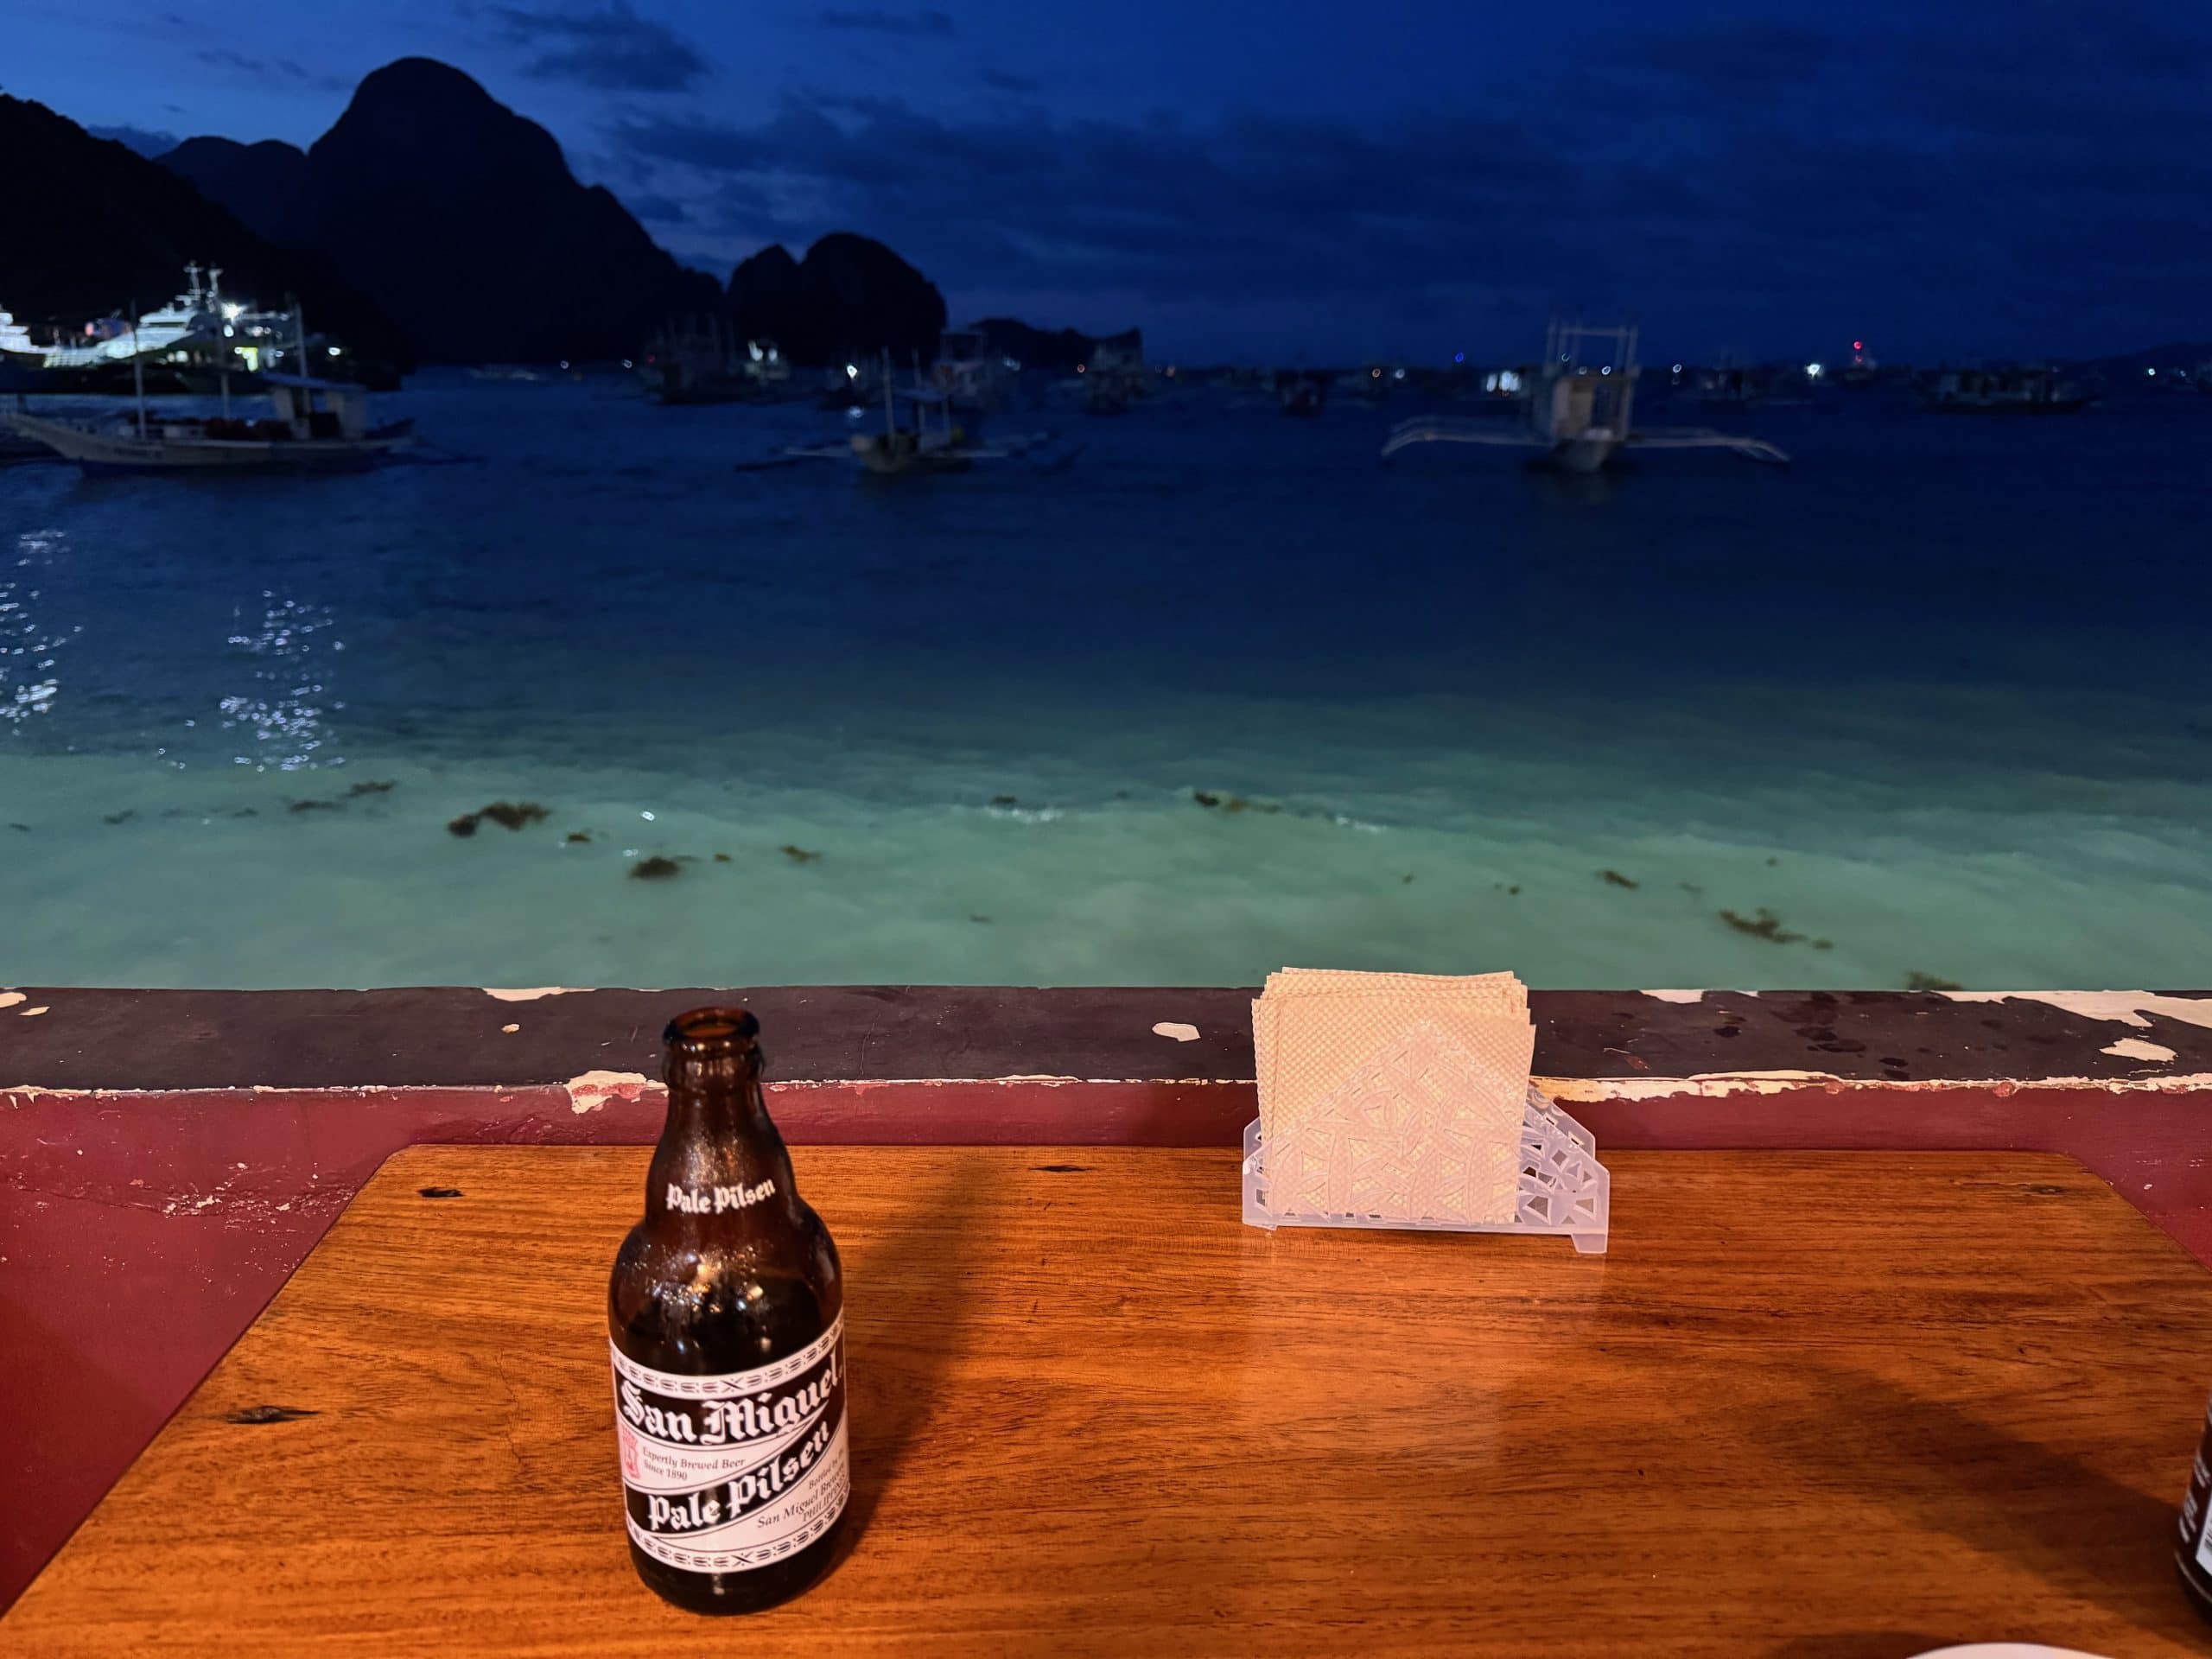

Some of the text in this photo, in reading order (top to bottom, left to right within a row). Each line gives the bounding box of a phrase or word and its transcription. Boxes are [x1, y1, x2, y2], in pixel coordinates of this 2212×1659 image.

[666, 1179, 776, 1215] Pale Pilsen
[620, 1353, 837, 1446] San Miguel
[643, 1446, 746, 1470] Expertly Brewed Beer
[643, 1459, 688, 1480] Since 1890
[648, 1421, 830, 1531] Pale Pilsen
[757, 1514, 780, 1529] San
[783, 1489, 818, 1520] Miguel
